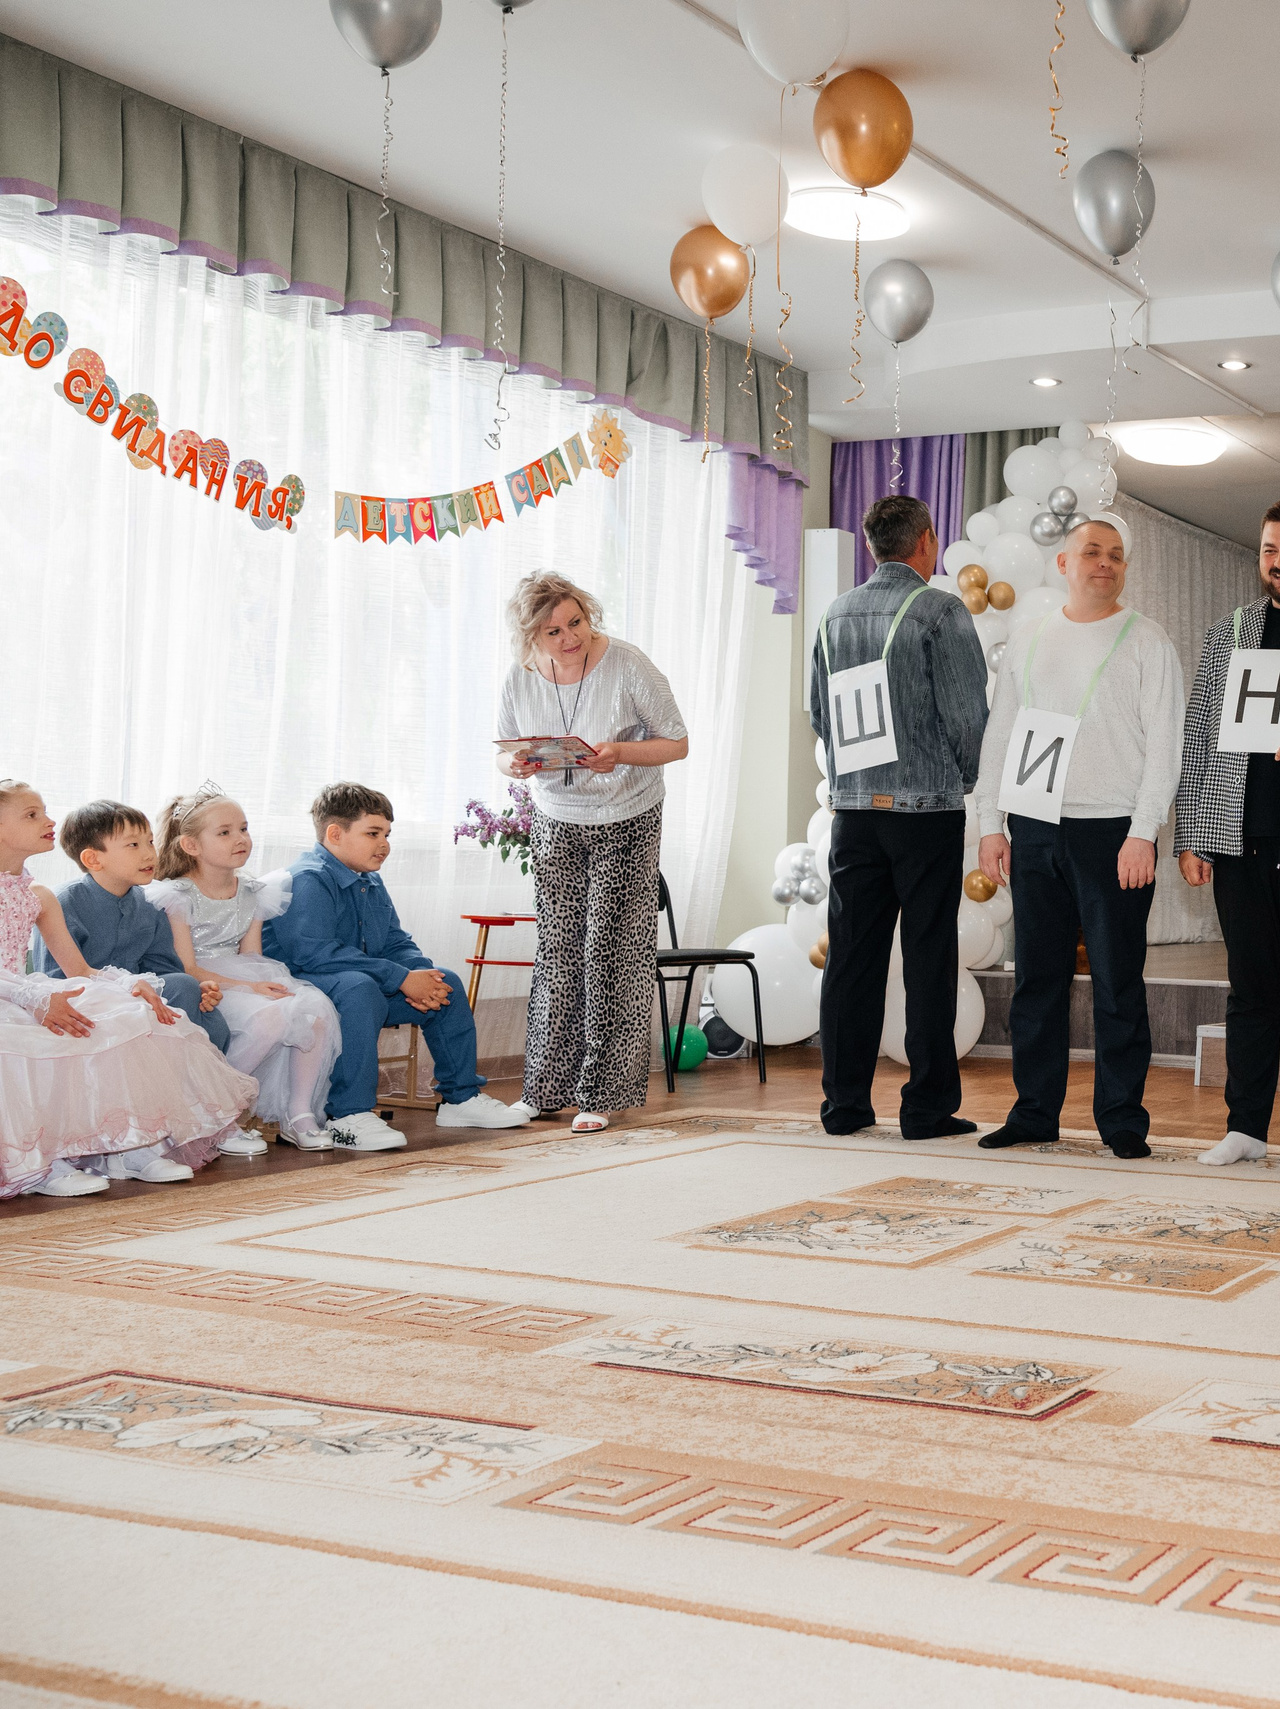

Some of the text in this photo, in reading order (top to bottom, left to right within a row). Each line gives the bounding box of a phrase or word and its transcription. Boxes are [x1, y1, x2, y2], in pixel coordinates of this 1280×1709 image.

[0, 299, 293, 530] ДО СВИДАНИЯ,
[336, 439, 584, 534] ДЕТСКИЙ САД!
[834, 683, 886, 747] Ш
[1015, 729, 1064, 793] И
